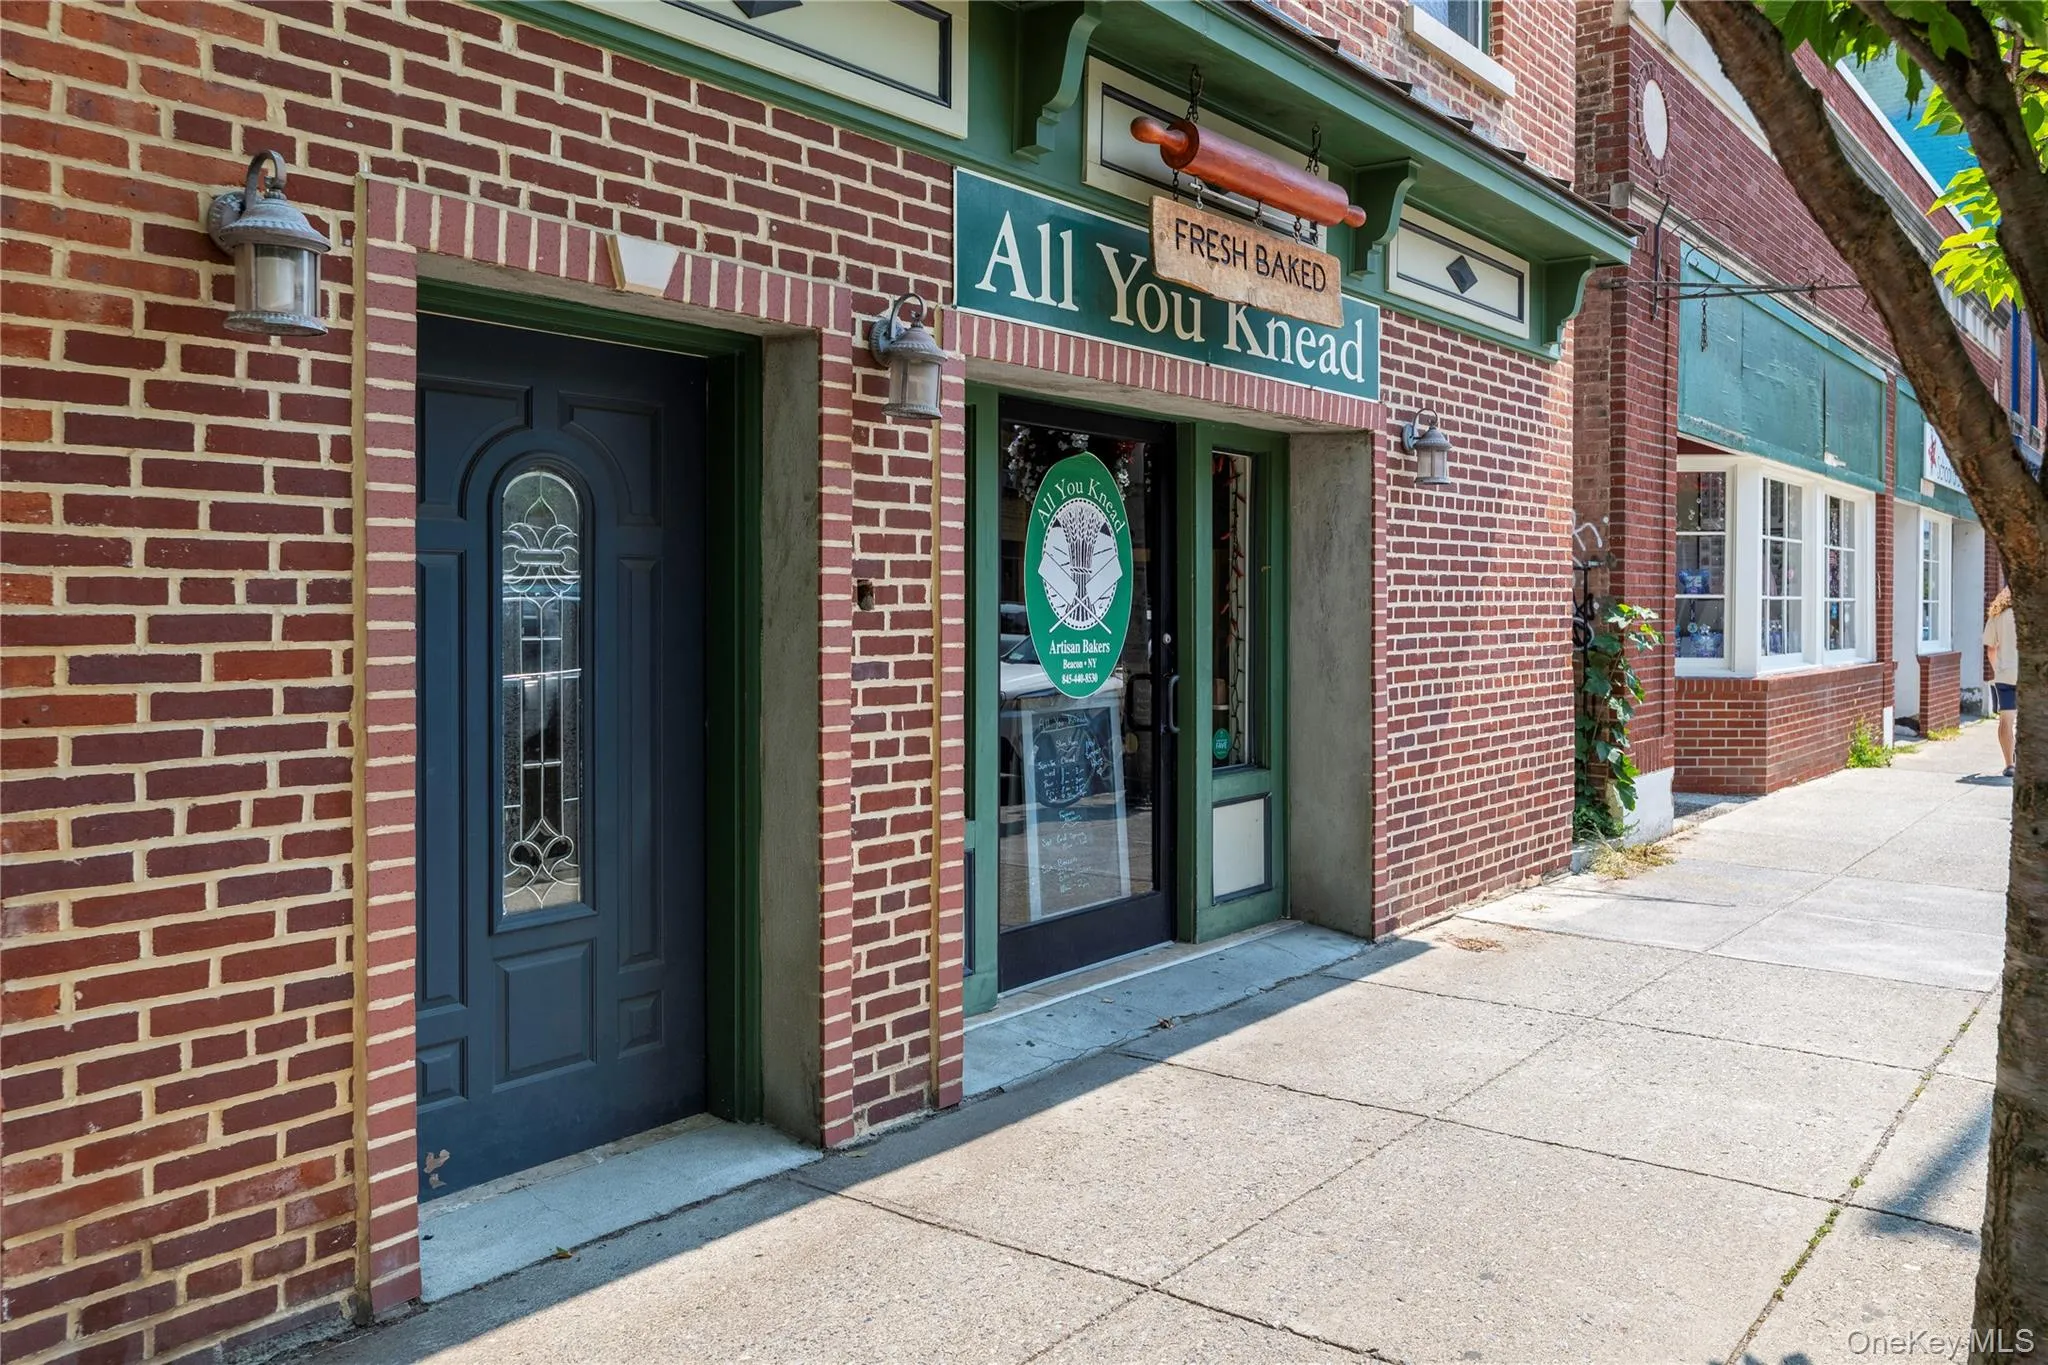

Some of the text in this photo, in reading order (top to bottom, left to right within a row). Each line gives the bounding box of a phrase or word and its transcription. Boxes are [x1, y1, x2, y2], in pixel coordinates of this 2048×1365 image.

[1175, 217, 1326, 293] FRESH BAKED
[975, 210, 1366, 384] All You Knead
[1037, 476, 1127, 534] All You Knead
[1049, 638, 1111, 655] Artisan Bakers
[1063, 657, 1098, 669] Beacon NY
